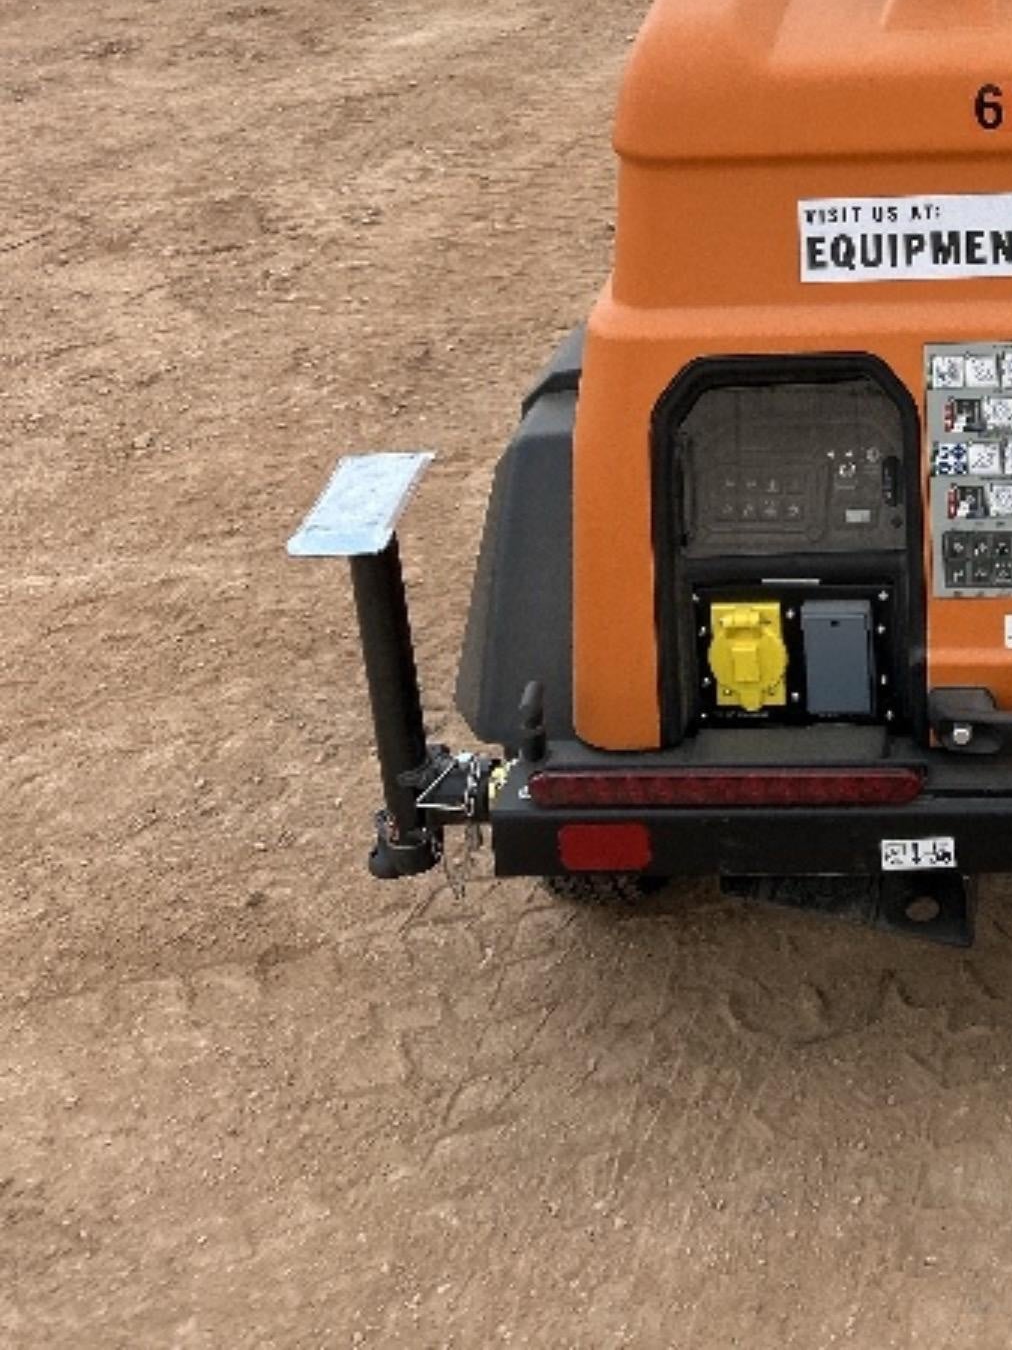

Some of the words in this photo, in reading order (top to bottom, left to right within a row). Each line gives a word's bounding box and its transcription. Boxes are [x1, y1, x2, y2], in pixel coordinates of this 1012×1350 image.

[804, 205, 862, 224] VISIT
[872, 205, 899, 223] US
[910, 203, 942, 221] AT:
